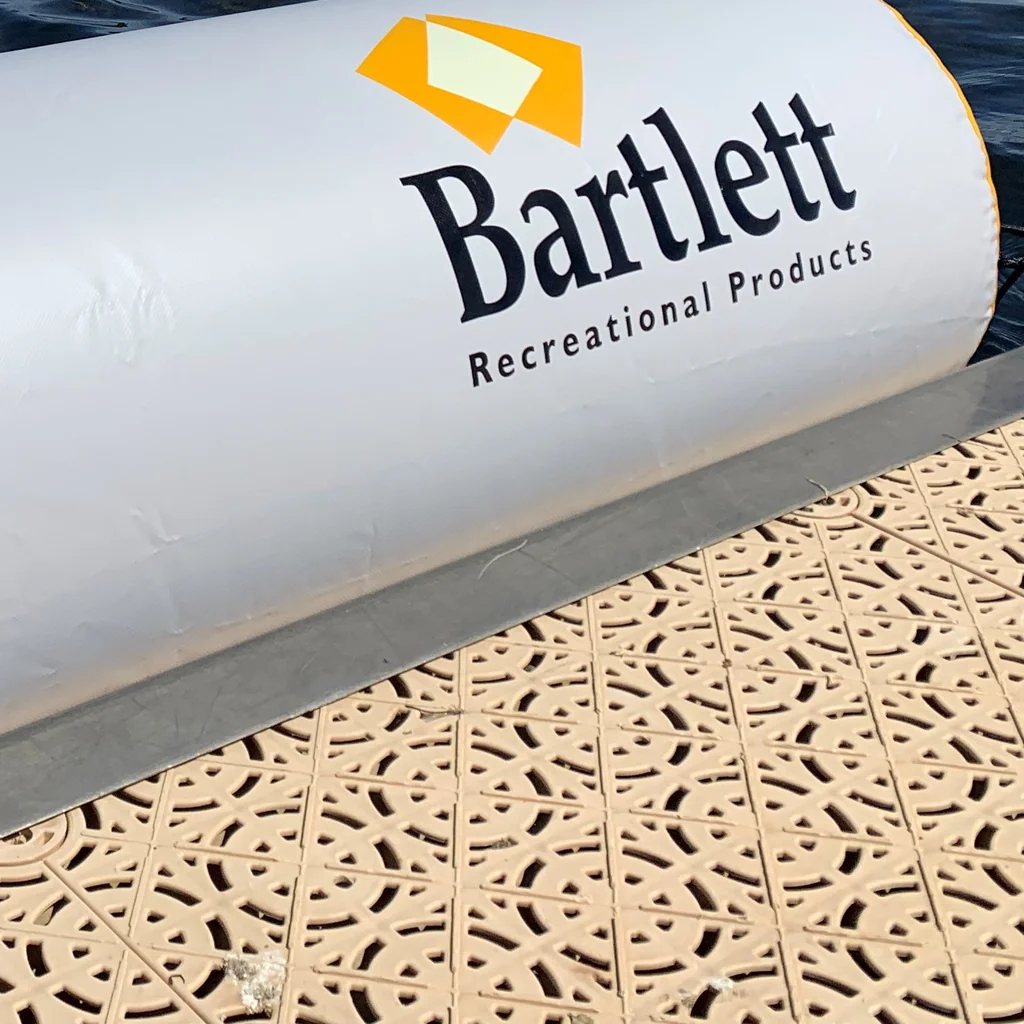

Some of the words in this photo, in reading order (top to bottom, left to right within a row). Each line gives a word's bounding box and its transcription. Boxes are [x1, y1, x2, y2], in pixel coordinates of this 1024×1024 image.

[399, 93, 857, 324] Bartlett
[468, 281, 711, 388] Recreational
[728, 240, 872, 304] Products
